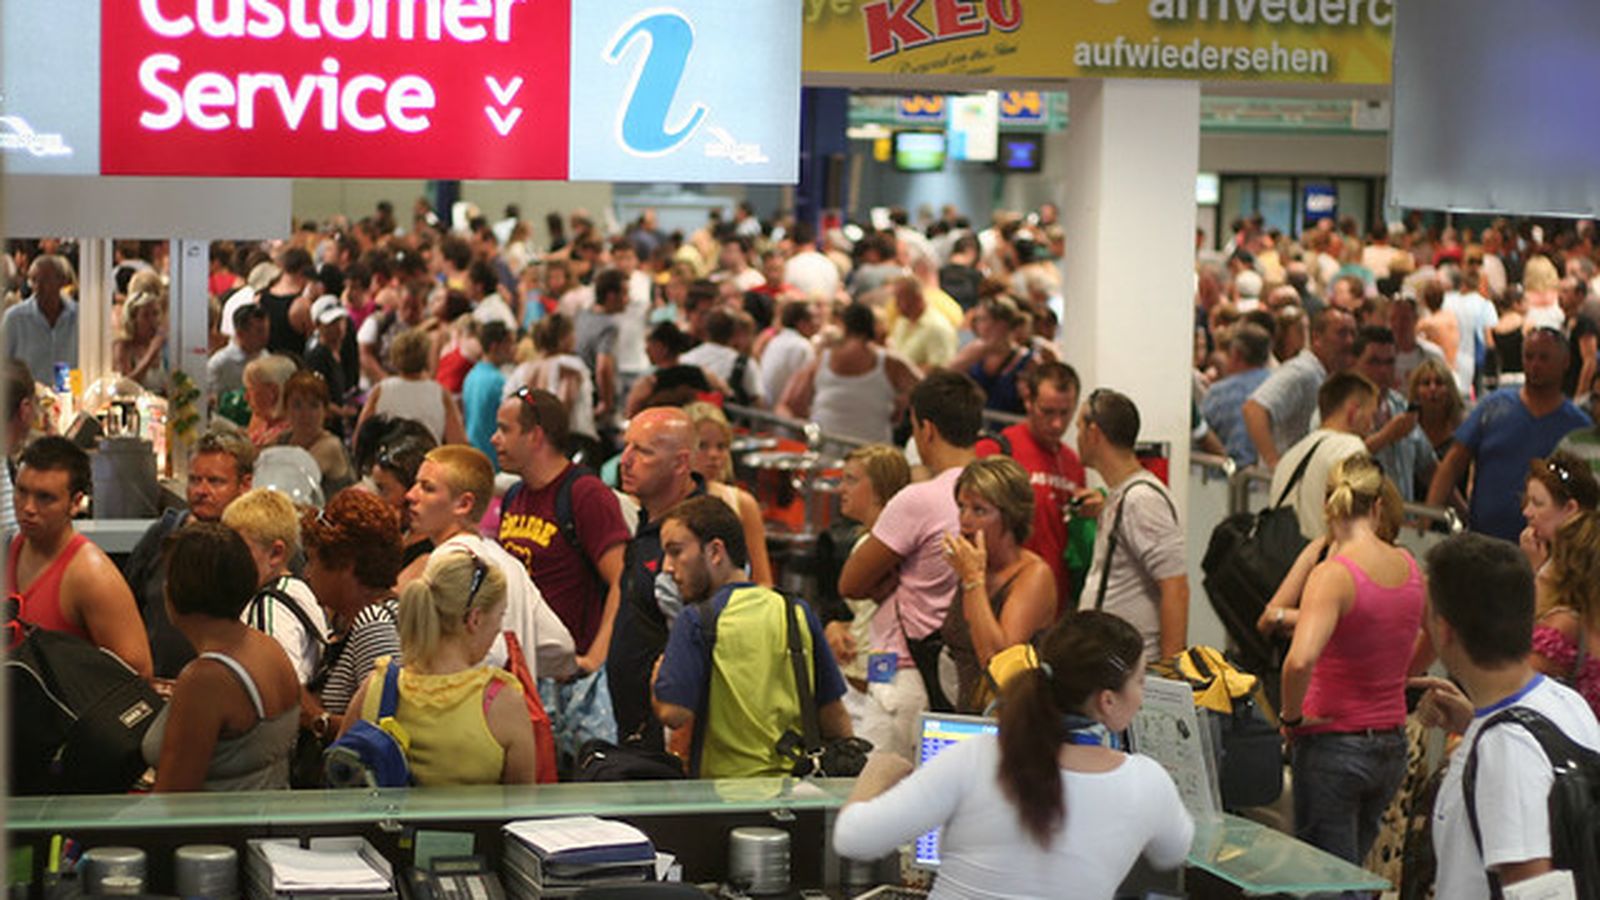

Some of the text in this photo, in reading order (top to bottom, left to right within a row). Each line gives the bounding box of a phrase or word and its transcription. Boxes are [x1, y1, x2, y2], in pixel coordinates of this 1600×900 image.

[139, 0, 526, 42] Customer
[1073, 36, 1329, 73] aufwiedersehen
[138, 52, 437, 133] Service
